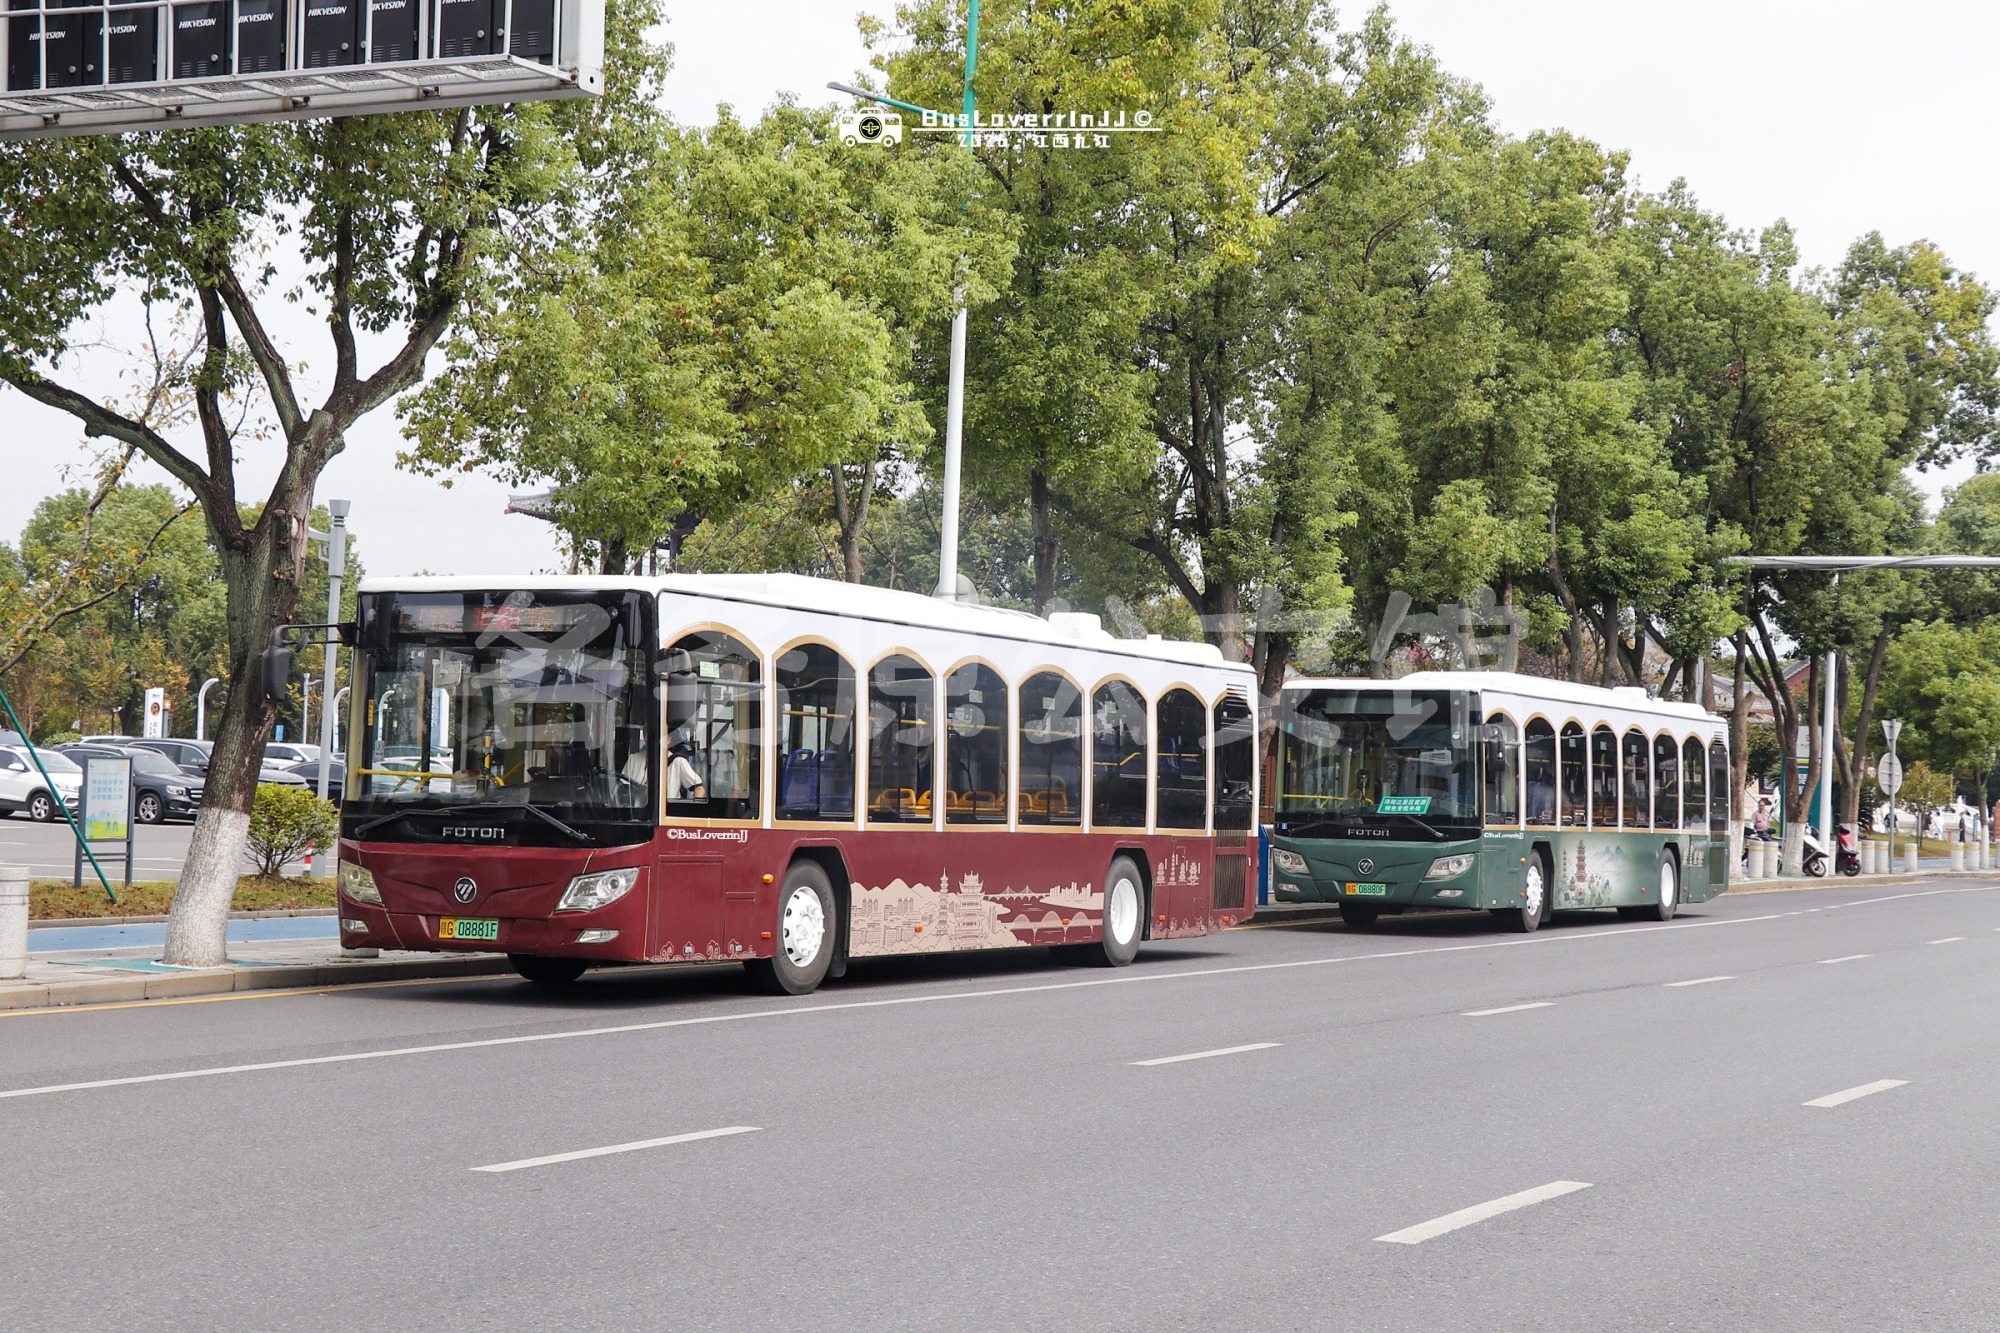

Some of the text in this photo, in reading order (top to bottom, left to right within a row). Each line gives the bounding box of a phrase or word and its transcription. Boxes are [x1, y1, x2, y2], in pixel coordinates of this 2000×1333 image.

[371, 0, 406, 11] IKVISION
[308, 6, 347, 17] HIKVISION
[178, 18, 217, 29] HIKVISION
[99, 25, 137, 35] HKVISION
[442, 826, 505, 839] FOTON
[1347, 828, 1390, 837] FOTON
